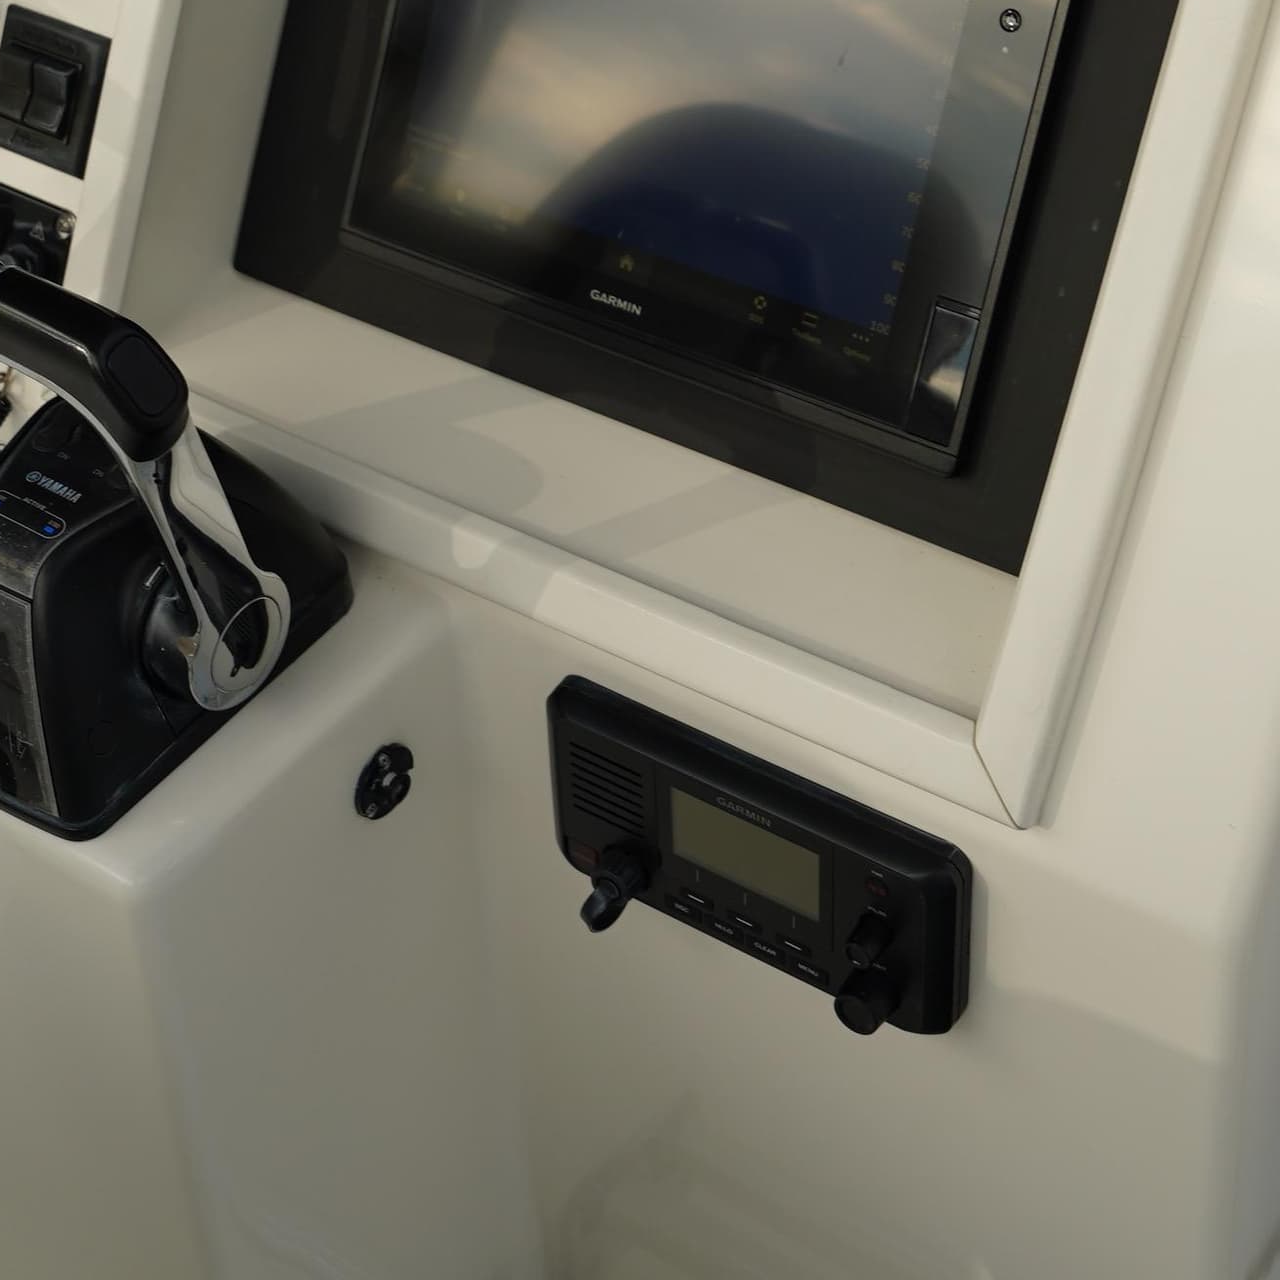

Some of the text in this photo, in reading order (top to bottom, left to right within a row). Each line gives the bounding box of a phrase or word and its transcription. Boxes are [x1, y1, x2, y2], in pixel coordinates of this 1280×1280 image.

[589, 288, 642, 316] GARMIN
[22, 496, 47, 511] ACTIVE
[37, 475, 83, 504] YAMAHA
[715, 796, 772, 828] GARMIN
